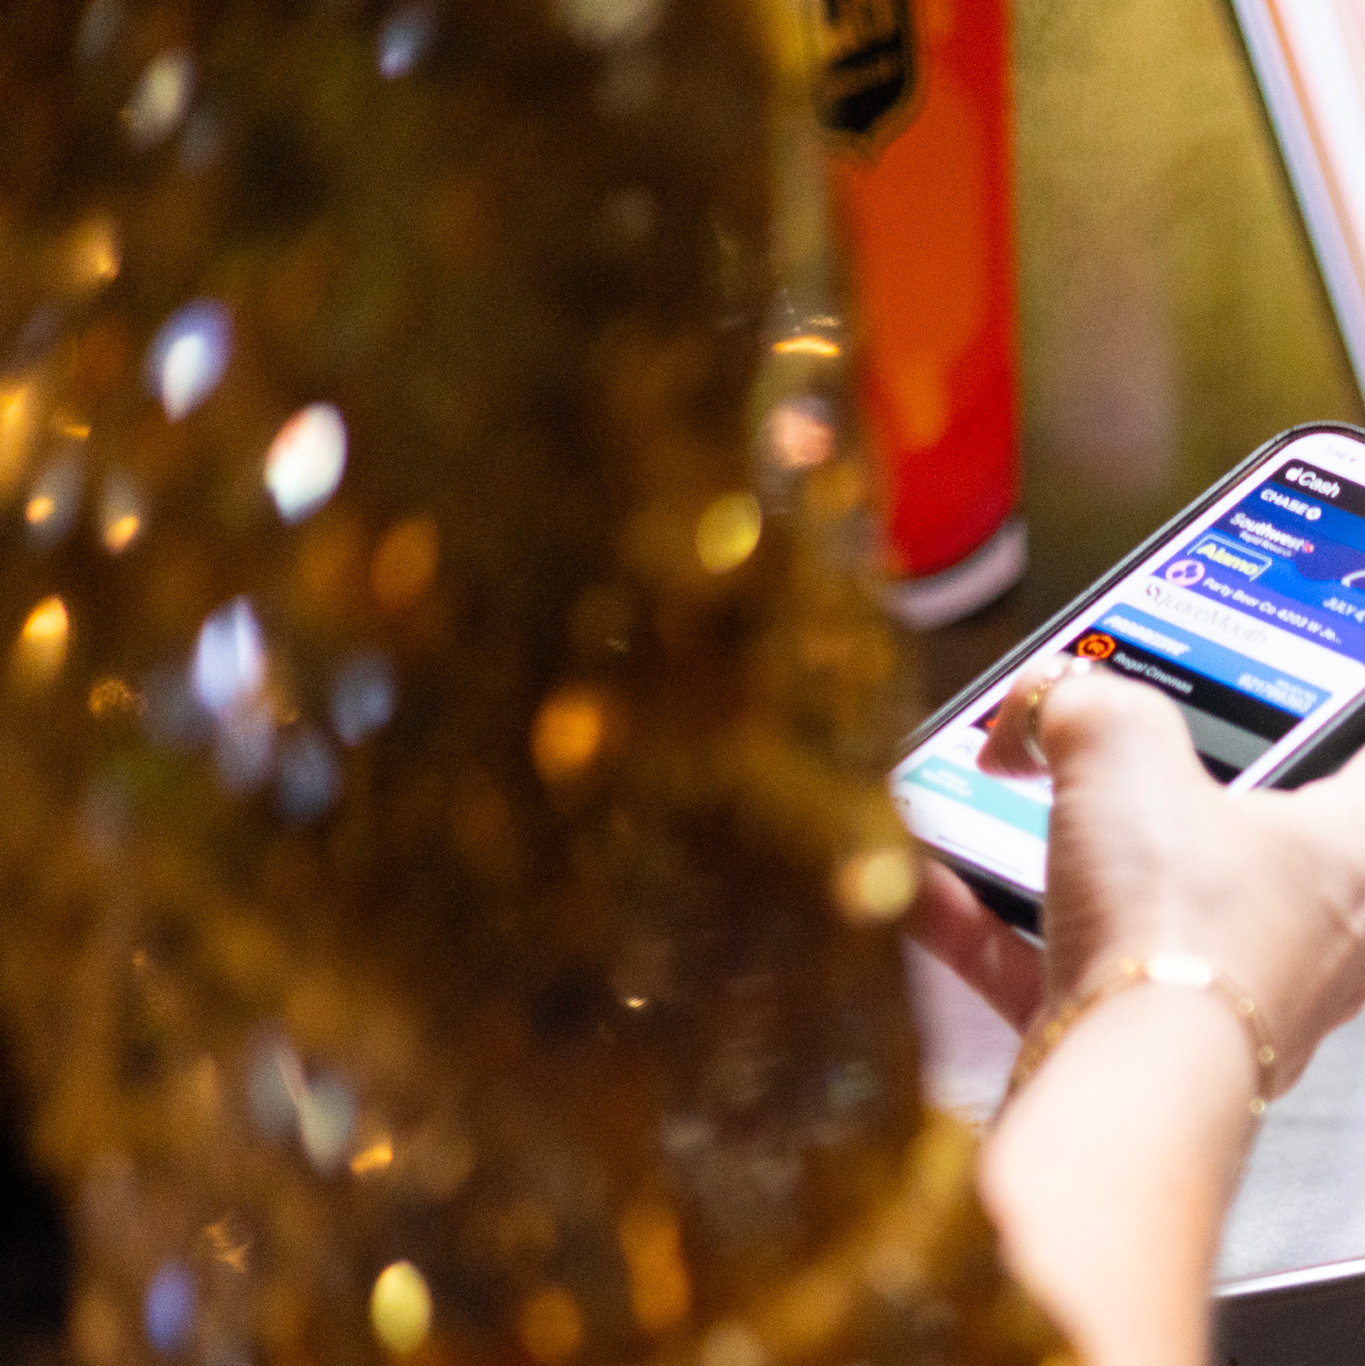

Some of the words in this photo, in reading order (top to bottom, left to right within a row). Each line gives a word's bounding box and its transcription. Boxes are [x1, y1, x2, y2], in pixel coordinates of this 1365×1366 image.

[1298, 471, 1341, 498] Cash
[1260, 488, 1310, 516] CHASE
[1230, 512, 1306, 551] Southwest
[1196, 543, 1259, 576] Alamo
[1203, 577, 1234, 597] Party
[1259, 601, 1277, 615] Co
